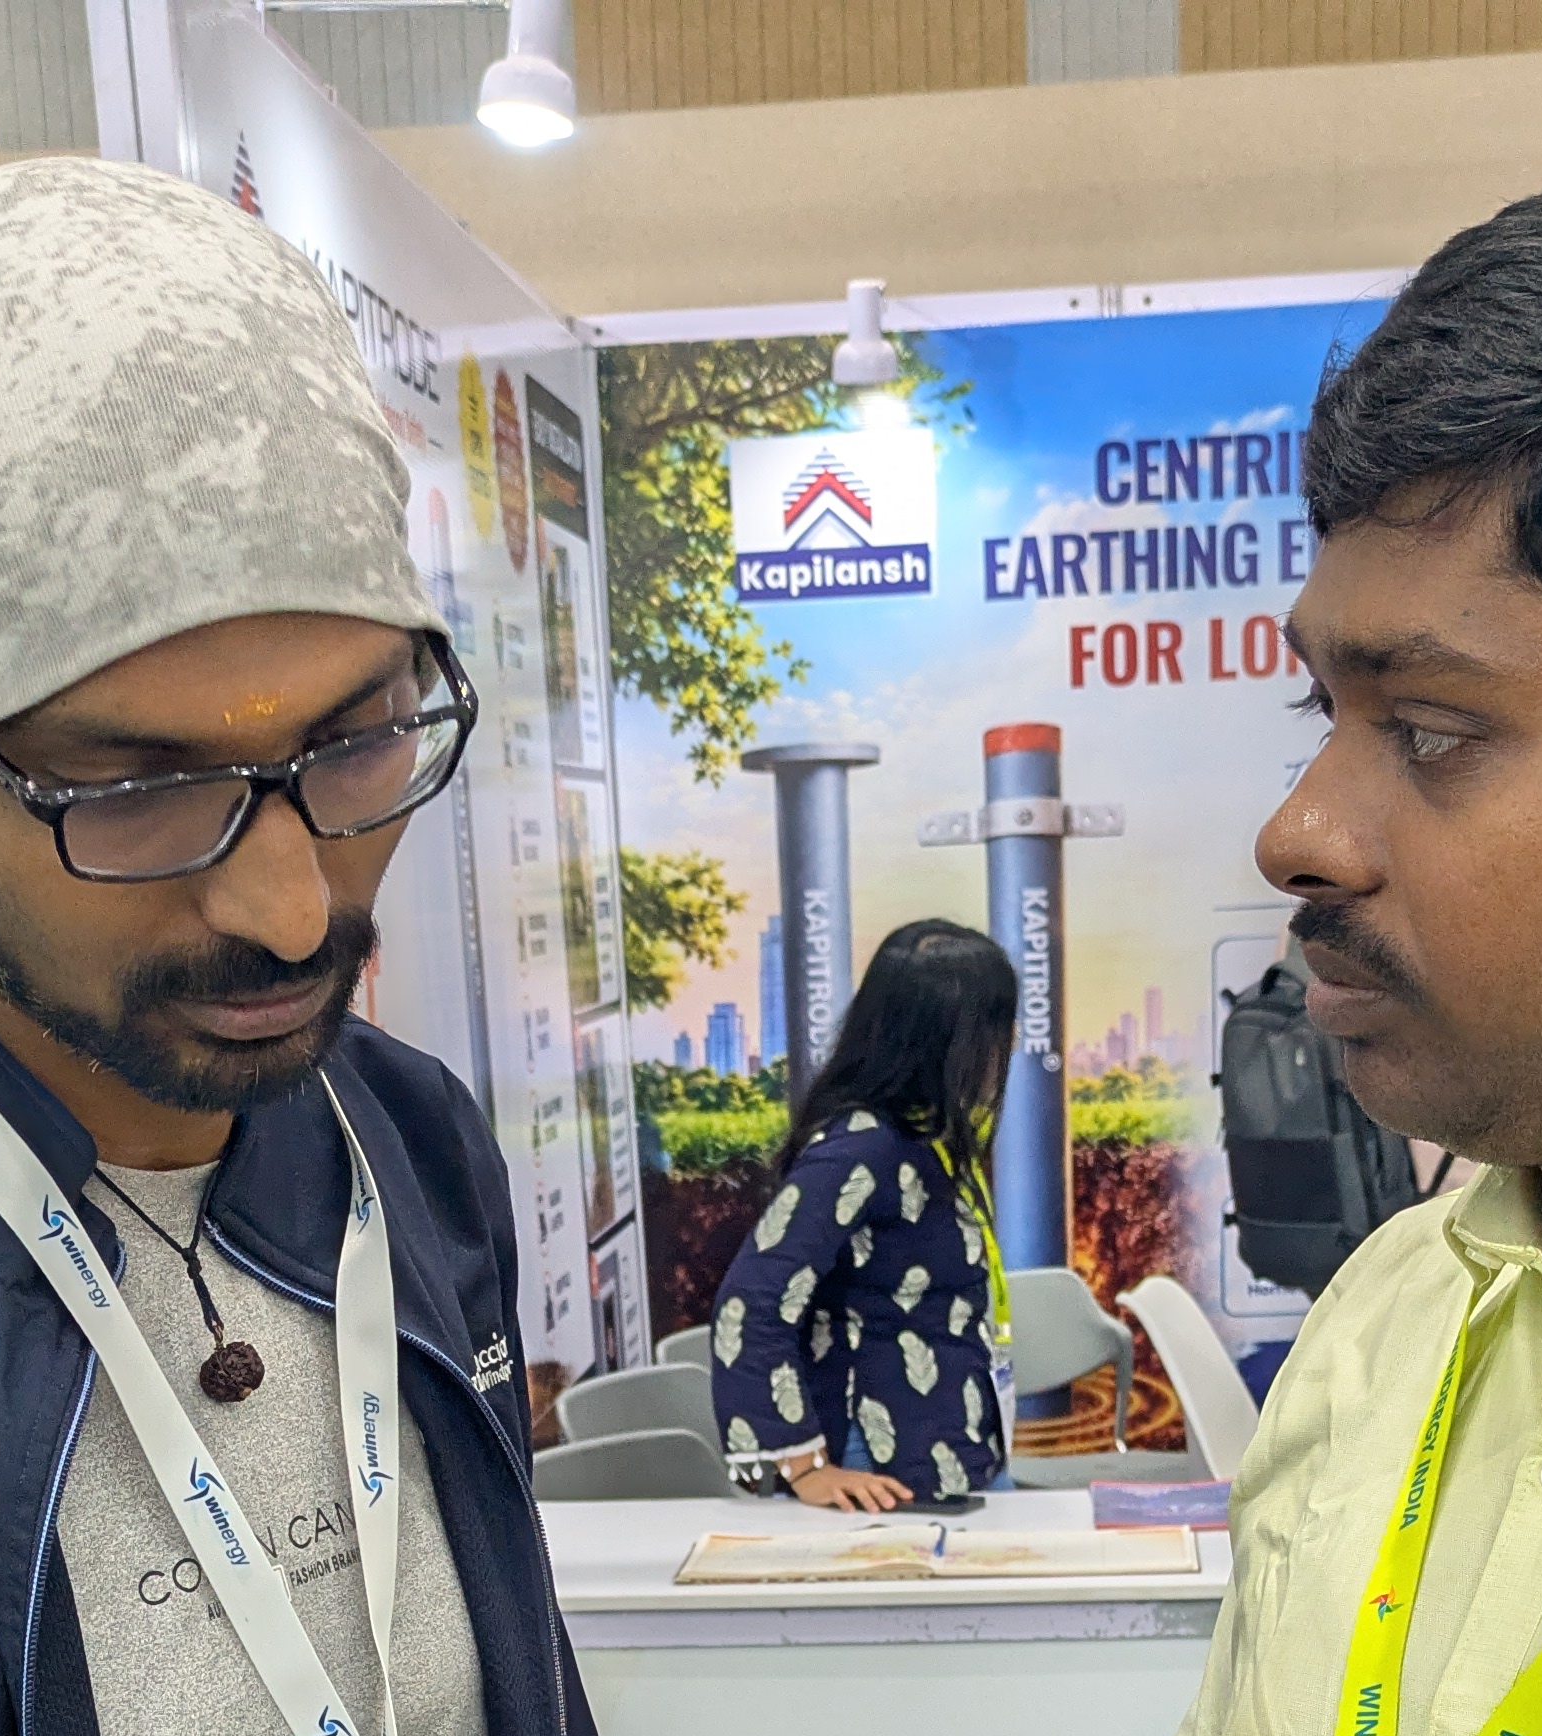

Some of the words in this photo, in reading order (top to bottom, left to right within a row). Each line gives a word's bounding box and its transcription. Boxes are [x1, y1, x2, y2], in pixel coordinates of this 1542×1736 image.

[302, 240, 440, 404] PITRODE
[1095, 434, 1306, 505] CENTRI
[740, 552, 927, 596] Kapilansh
[985, 523, 1258, 600] EARTHING
[1069, 622, 1183, 690] FOR
[1022, 886, 1052, 1055] KAPITRODE
[60, 1234, 111, 1310] winergy
[361, 1391, 380, 1468] winergy
[1400, 1458, 1430, 1531] INDIA
[204, 1496, 251, 1567] winergy
[290, 1561, 331, 1589] FASHION
